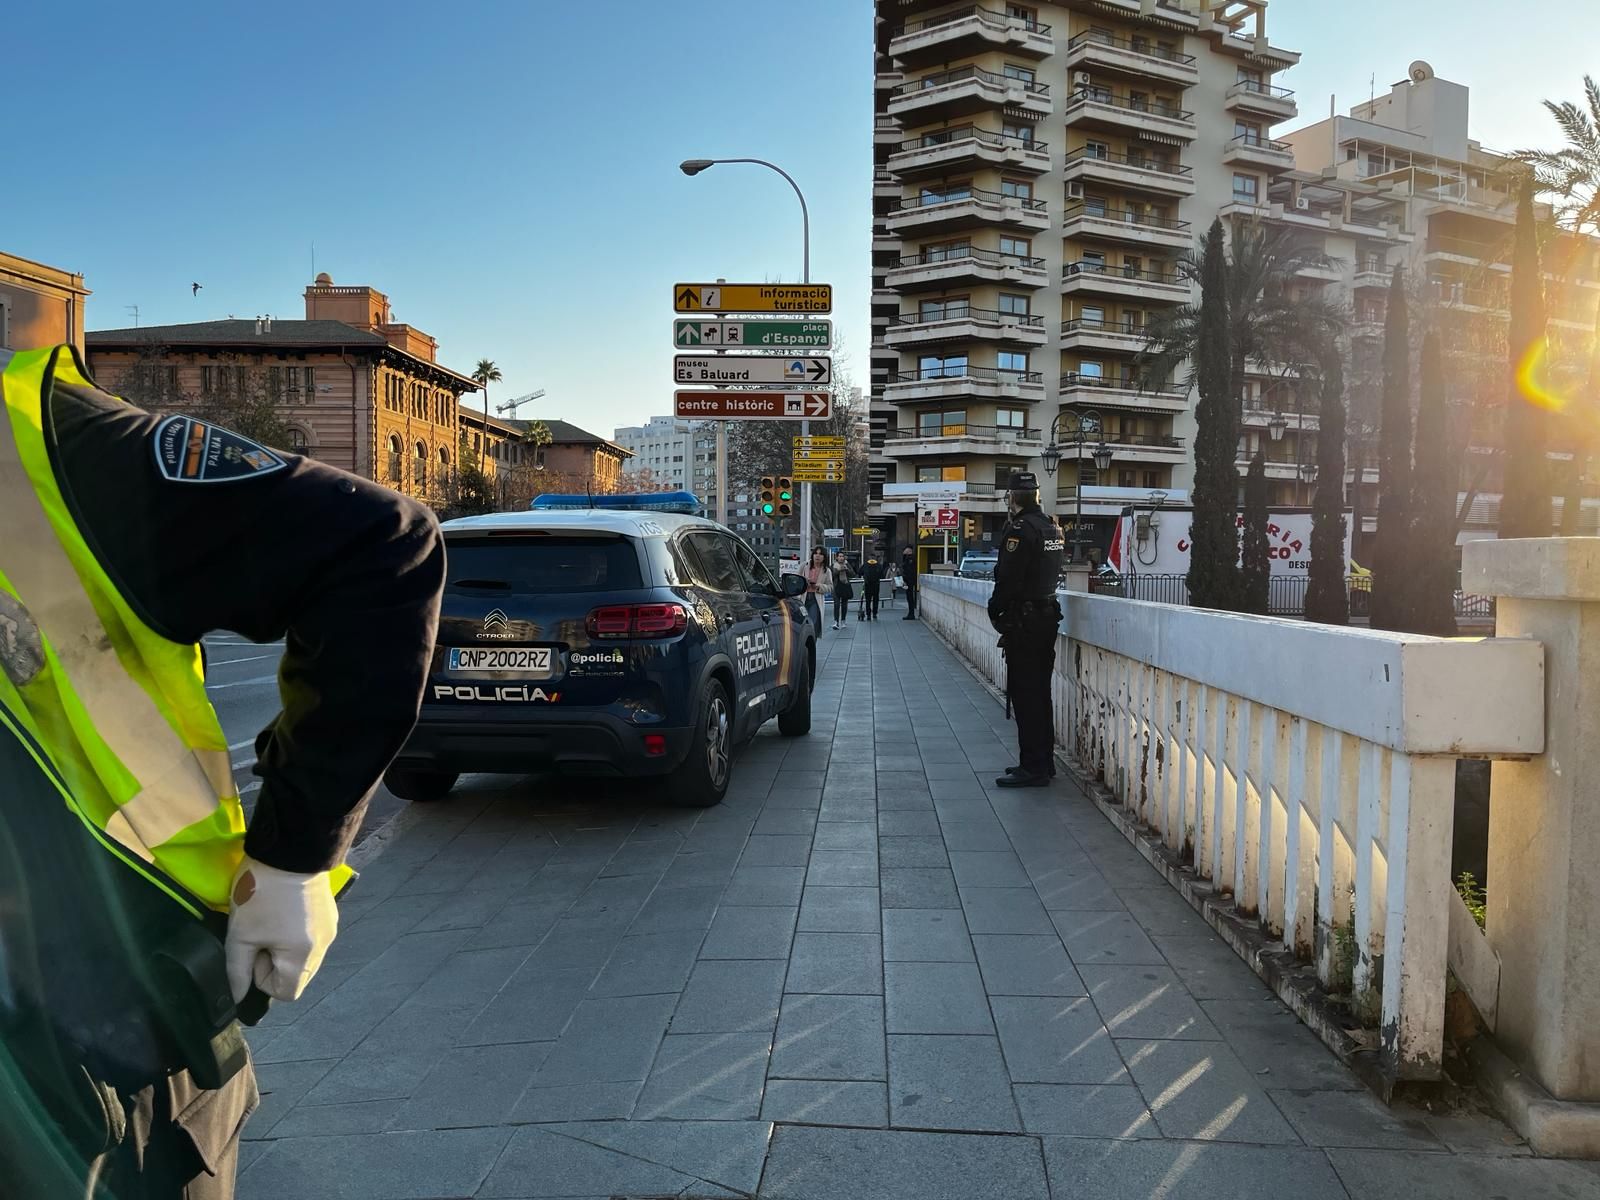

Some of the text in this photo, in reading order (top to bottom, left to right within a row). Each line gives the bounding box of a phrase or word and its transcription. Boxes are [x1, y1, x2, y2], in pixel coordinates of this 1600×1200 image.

[802, 324, 828, 332] plaça
[762, 333, 828, 345] d'Espanya
[678, 360, 709, 368] museu
[678, 369, 749, 380] Es Baluard
[678, 399, 774, 411] centre històric
[208, 437, 223, 467] PALMA
[459, 651, 548, 667] CNP2002RZ
[570, 653, 624, 665] @policia
[738, 649, 777, 678] NACIONAL
[433, 685, 550, 702] POLICÍA
